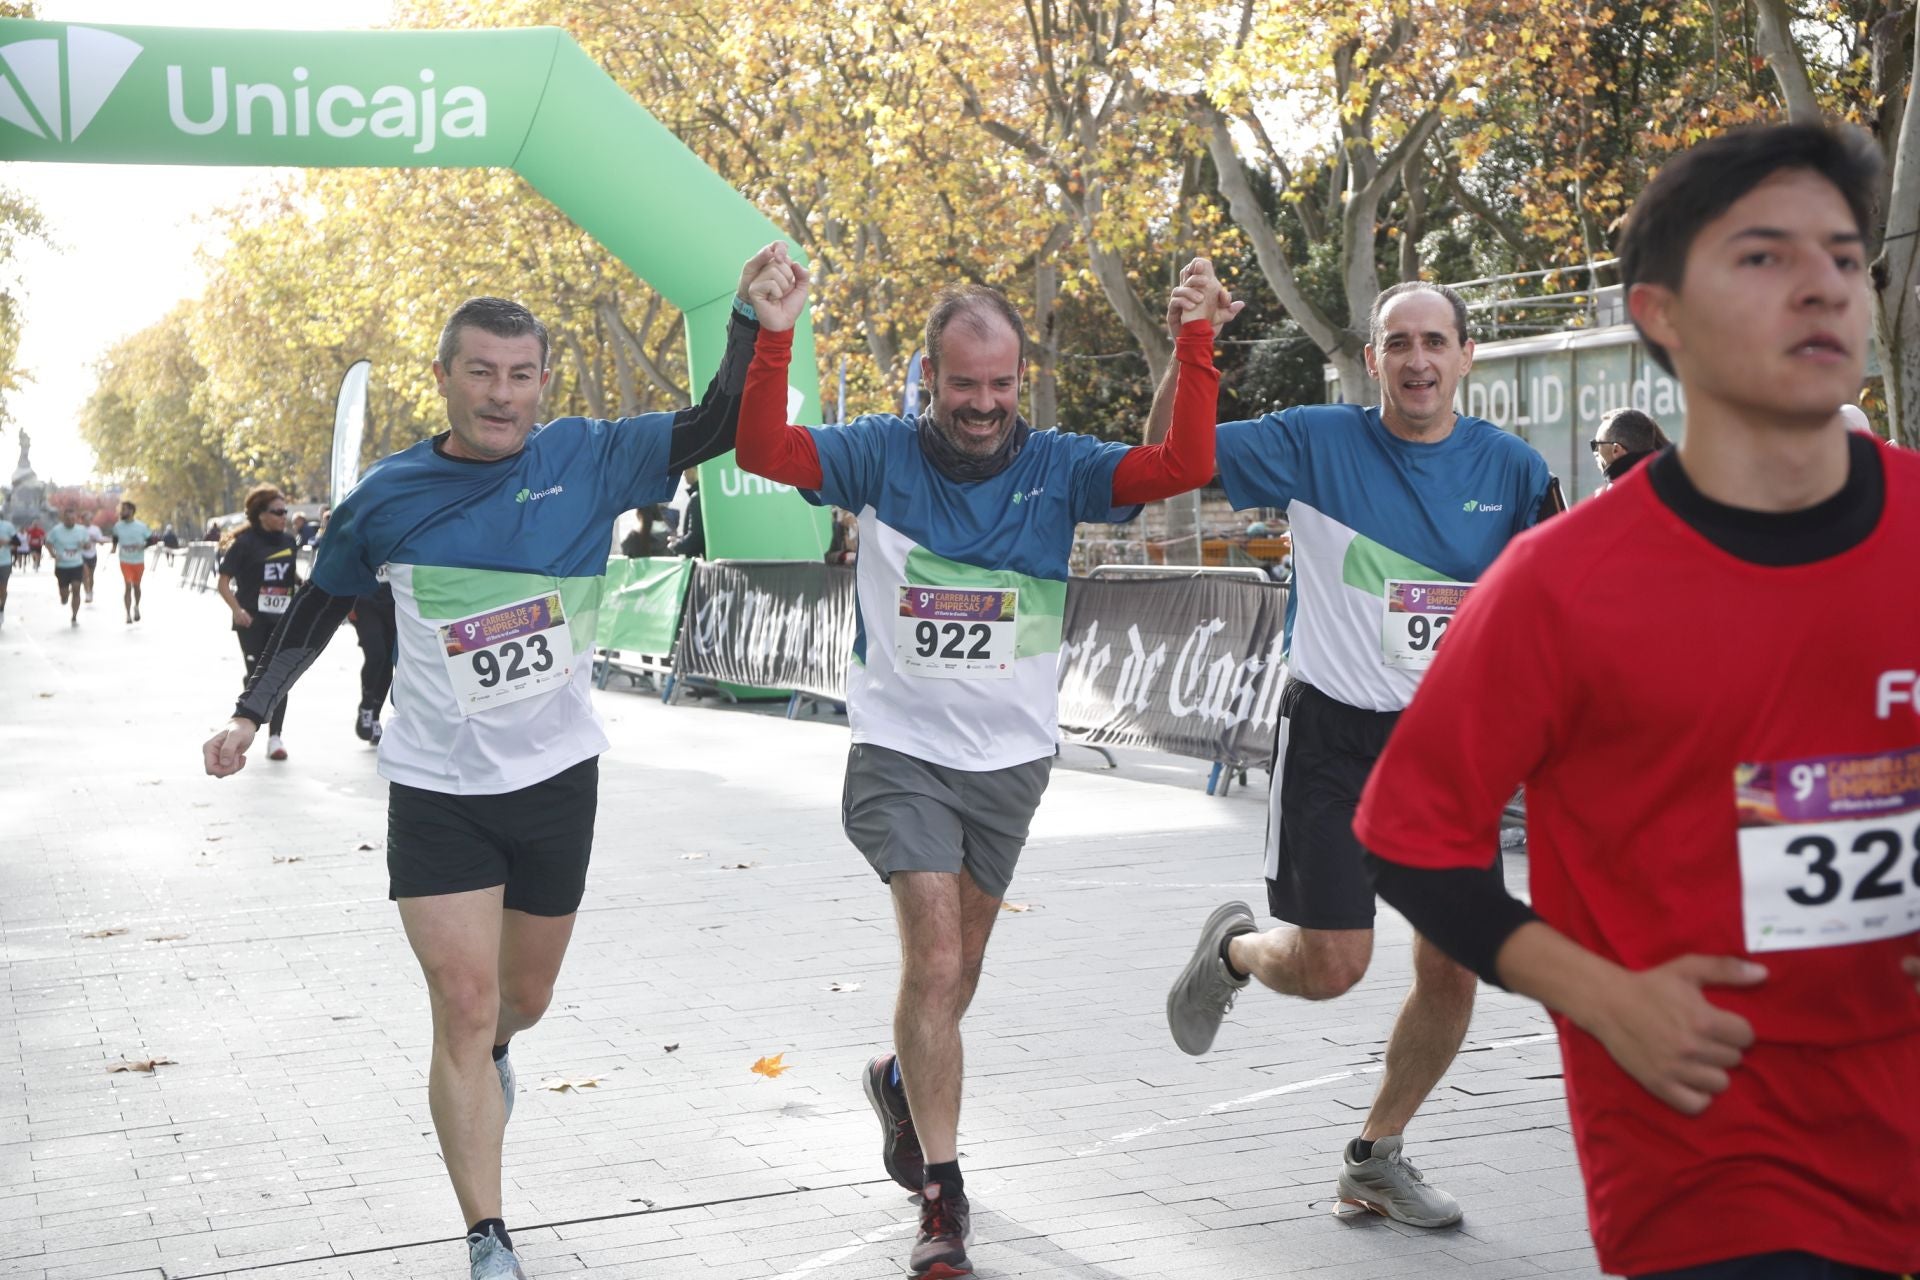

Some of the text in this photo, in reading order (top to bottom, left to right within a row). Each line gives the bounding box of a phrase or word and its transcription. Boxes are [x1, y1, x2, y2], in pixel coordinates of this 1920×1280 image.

[166, 65, 487, 154] Unicaja
[529, 485, 563, 501] Unicaja
[263, 562, 289, 581] EY
[934, 601, 980, 612] EMPRESAS
[935, 593, 981, 603] CARRERA DE
[1426, 588, 1459, 597] CARRERA
[480, 607, 528, 627] CARRERA DE
[482, 615, 530, 636] EMPRESAS
[915, 620, 992, 660] 922
[1407, 614, 1452, 651] 92
[471, 634, 554, 688] 923
[1112, 623, 1166, 715] de
[1168, 617, 1289, 733] Casti
[1876, 669, 1920, 719] F
[1784, 822, 1920, 907] 32
